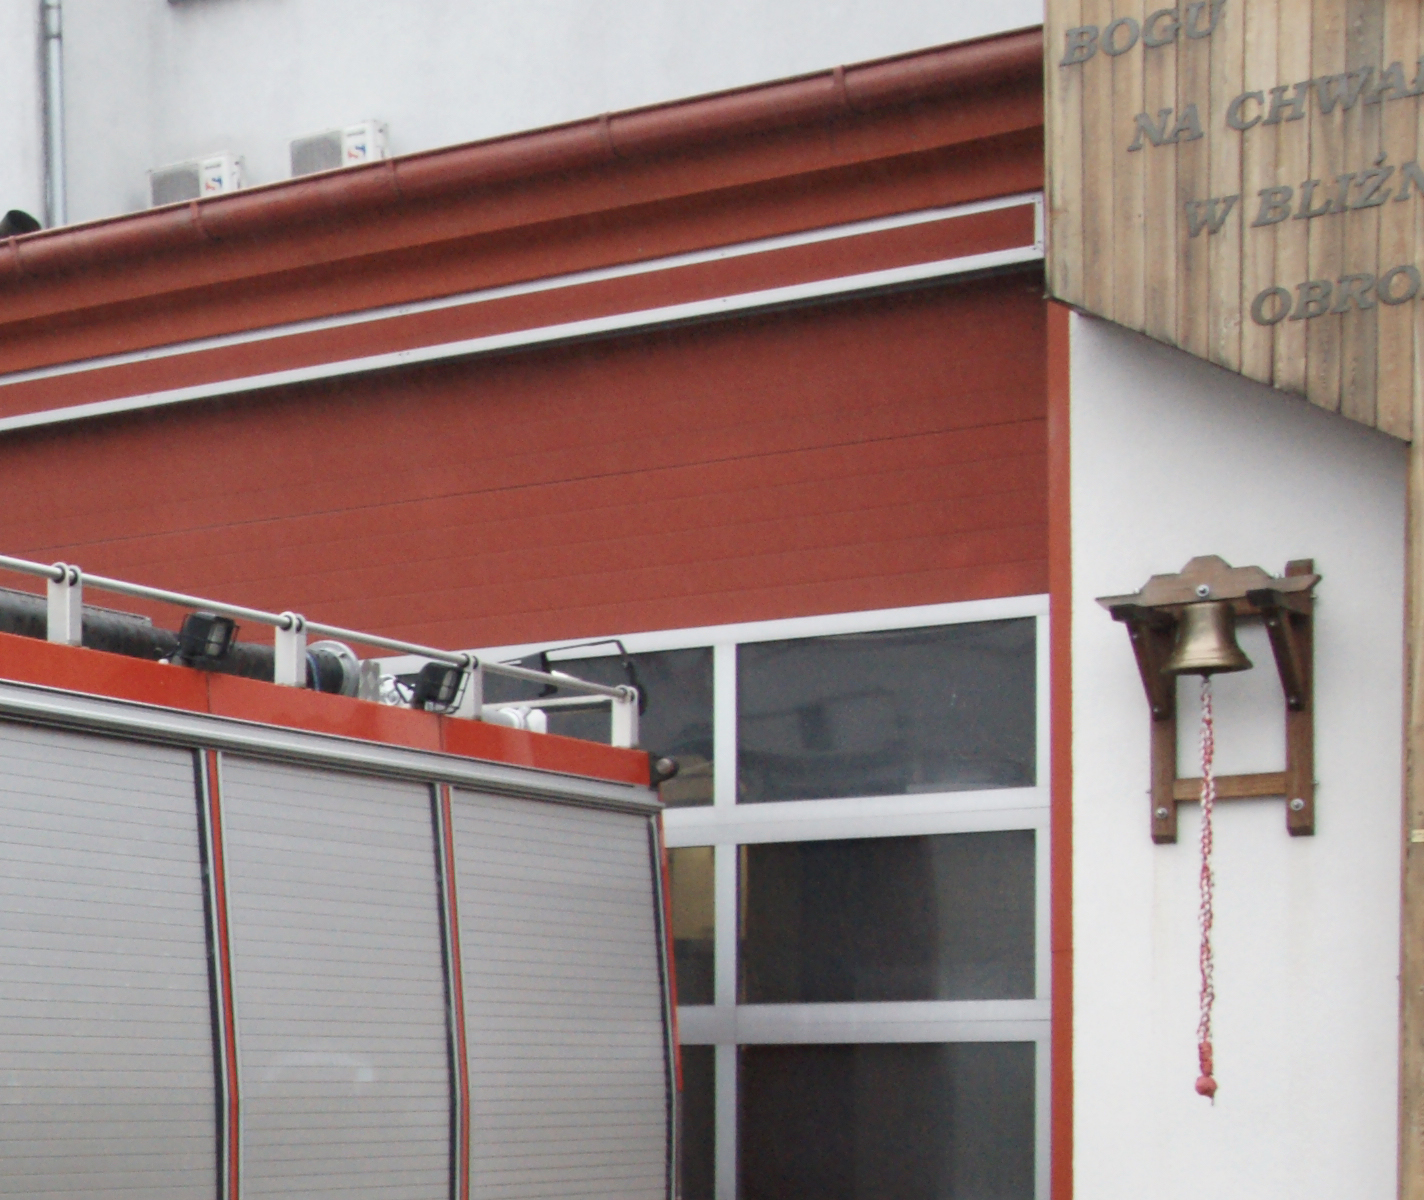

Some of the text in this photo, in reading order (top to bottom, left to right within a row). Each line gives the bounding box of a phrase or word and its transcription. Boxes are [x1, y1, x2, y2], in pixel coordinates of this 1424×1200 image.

[1059, 0, 1228, 67] BOGU
[1127, 103, 1204, 152] NA
[1184, 194, 1240, 238] W
[1250, 265, 1424, 326] OBRO
